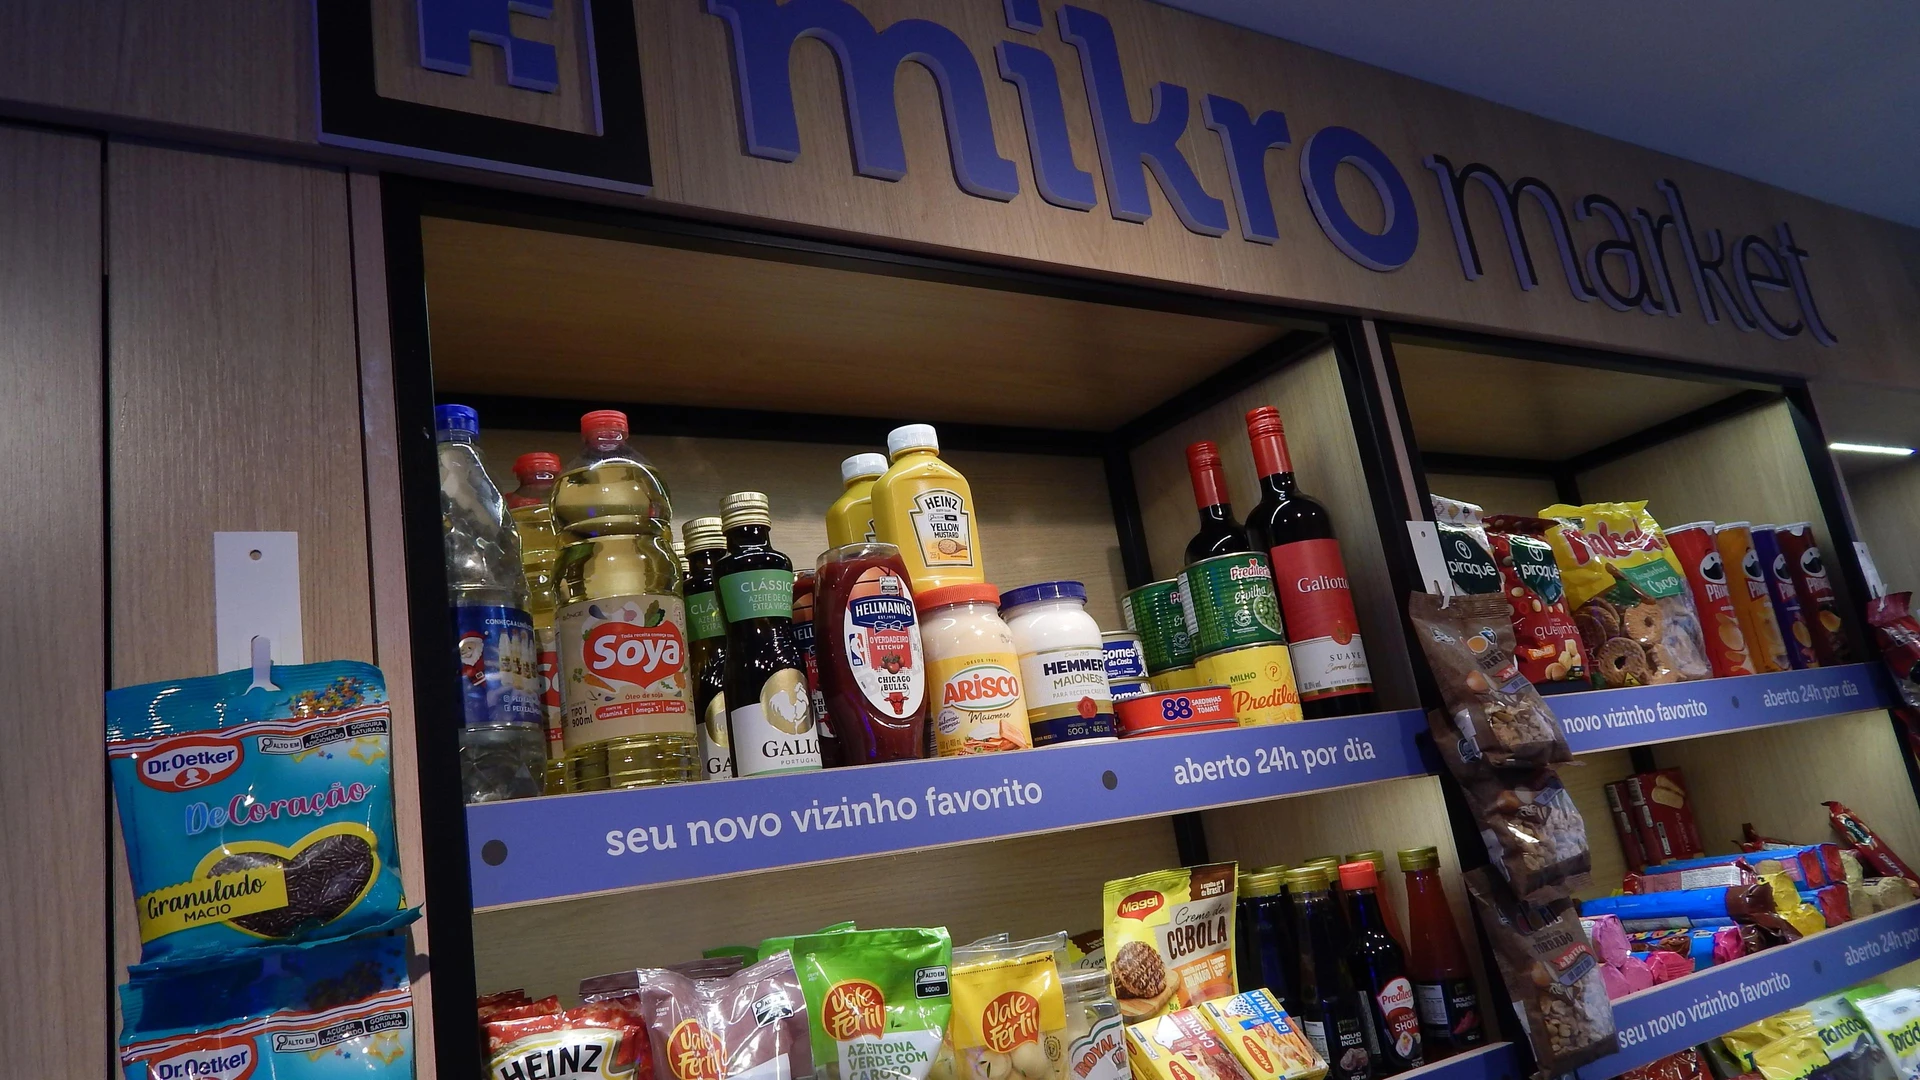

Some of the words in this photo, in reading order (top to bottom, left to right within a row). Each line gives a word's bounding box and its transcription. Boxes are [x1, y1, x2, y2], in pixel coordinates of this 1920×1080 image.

[706, 0, 1420, 272] mikro
[1424, 154, 1838, 347] market
[925, 496, 957, 510] HEINZ
[930, 523, 959, 531] YELLOW
[1448, 558, 1496, 579] piraquê
[1521, 562, 1560, 581] piraquê
[748, 594, 772, 603] AZEITE
[1235, 584, 1266, 604] Ervilha
[752, 603, 773, 611] EXTRA
[855, 600, 912, 617] HELLMANN'S
[1534, 622, 1579, 640] queijinho
[593, 635, 680, 673] Soya
[1330, 651, 1362, 661] SUAVE
[1043, 659, 1104, 676] HEMMER
[878, 675, 911, 683] CHICAGO
[1053, 673, 1105, 690] MAIONESE
[1230, 672, 1257, 683] MILHO
[625, 692, 640, 700] Óleo
[884, 683, 907, 691] BULLS
[944, 674, 1019, 705] ARISCO
[1763, 688, 1800, 708] aberto
[1800, 684, 1822, 702] 24h
[1822, 685, 1841, 704] por
[1842, 680, 1859, 697] dia
[1161, 697, 1194, 720] 88
[1191, 695, 1222, 706] SARDINHAS
[1197, 704, 1220, 714] TOMATE
[571, 707, 582, 717] TIPO
[968, 711, 1012, 724] Maionese
[1563, 713, 1601, 735] novo
[1602, 705, 1656, 730] vizinho
[1656, 699, 1708, 724] favorito
[351, 720, 383, 730] GORDURA
[351, 727, 385, 736] SATURADA
[273, 741, 289, 749] ALTO
[305, 732, 344, 748] ADICIONADO
[781, 757, 817, 765] PORTUGAL
[1173, 754, 1251, 785] aberto
[1255, 746, 1299, 774] 24h
[1302, 746, 1338, 772] por
[1343, 738, 1376, 762] dia
[605, 819, 676, 857] seu
[687, 812, 781, 847] novo
[788, 792, 918, 832] vizinho
[924, 777, 1044, 818] favorito
[147, 873, 267, 920] Granulado
[1122, 895, 1158, 914] Maggi
[184, 903, 231, 922] MACIO
[1175, 906, 1212, 926] Creme
[1212, 904, 1226, 917] de
[1167, 915, 1227, 960] CEBOLA
[1533, 932, 1574, 954] TORRADO
[1844, 941, 1881, 966] aberto
[1880, 930, 1902, 953] 24h
[1901, 928, 1920, 950] por
[925, 971, 936, 979] ALTO
[936, 970, 945, 978] EM
[925, 985, 941, 993] SÓDIO
[831, 986, 873, 1012] Vale
[986, 994, 1030, 1022] Vale
[370, 1013, 402, 1025] GORDURA
[1251, 991, 1290, 1033] GALINHA
[1618, 1025, 1646, 1049] seu
[1648, 1011, 1686, 1037] novo
[1687, 988, 1740, 1022] vizinho
[1740, 971, 1791, 1004] favorito
[370, 1019, 403, 1032] SATURADA
[832, 1007, 881, 1038] Fértil
[1182, 1014, 1216, 1049] CARNE
[321, 1029, 363, 1045] ADICIOADO
[990, 1011, 1039, 1053] Fértil
[1340, 1031, 1361, 1041] MOLHO
[1887, 1021, 1920, 1054] Torcid
[847, 1041, 916, 1057] AZEITONA
[1341, 1037, 1363, 1046] INGLÊS
[500, 1044, 602, 1080] HEINZ
[848, 1055, 893, 1070] VERDE
[895, 1050, 929, 1064] COM
[1074, 1034, 1117, 1079] ROYAL
[1244, 1039, 1272, 1070] Maggi
[849, 1065, 912, 1080] CAROÇO
